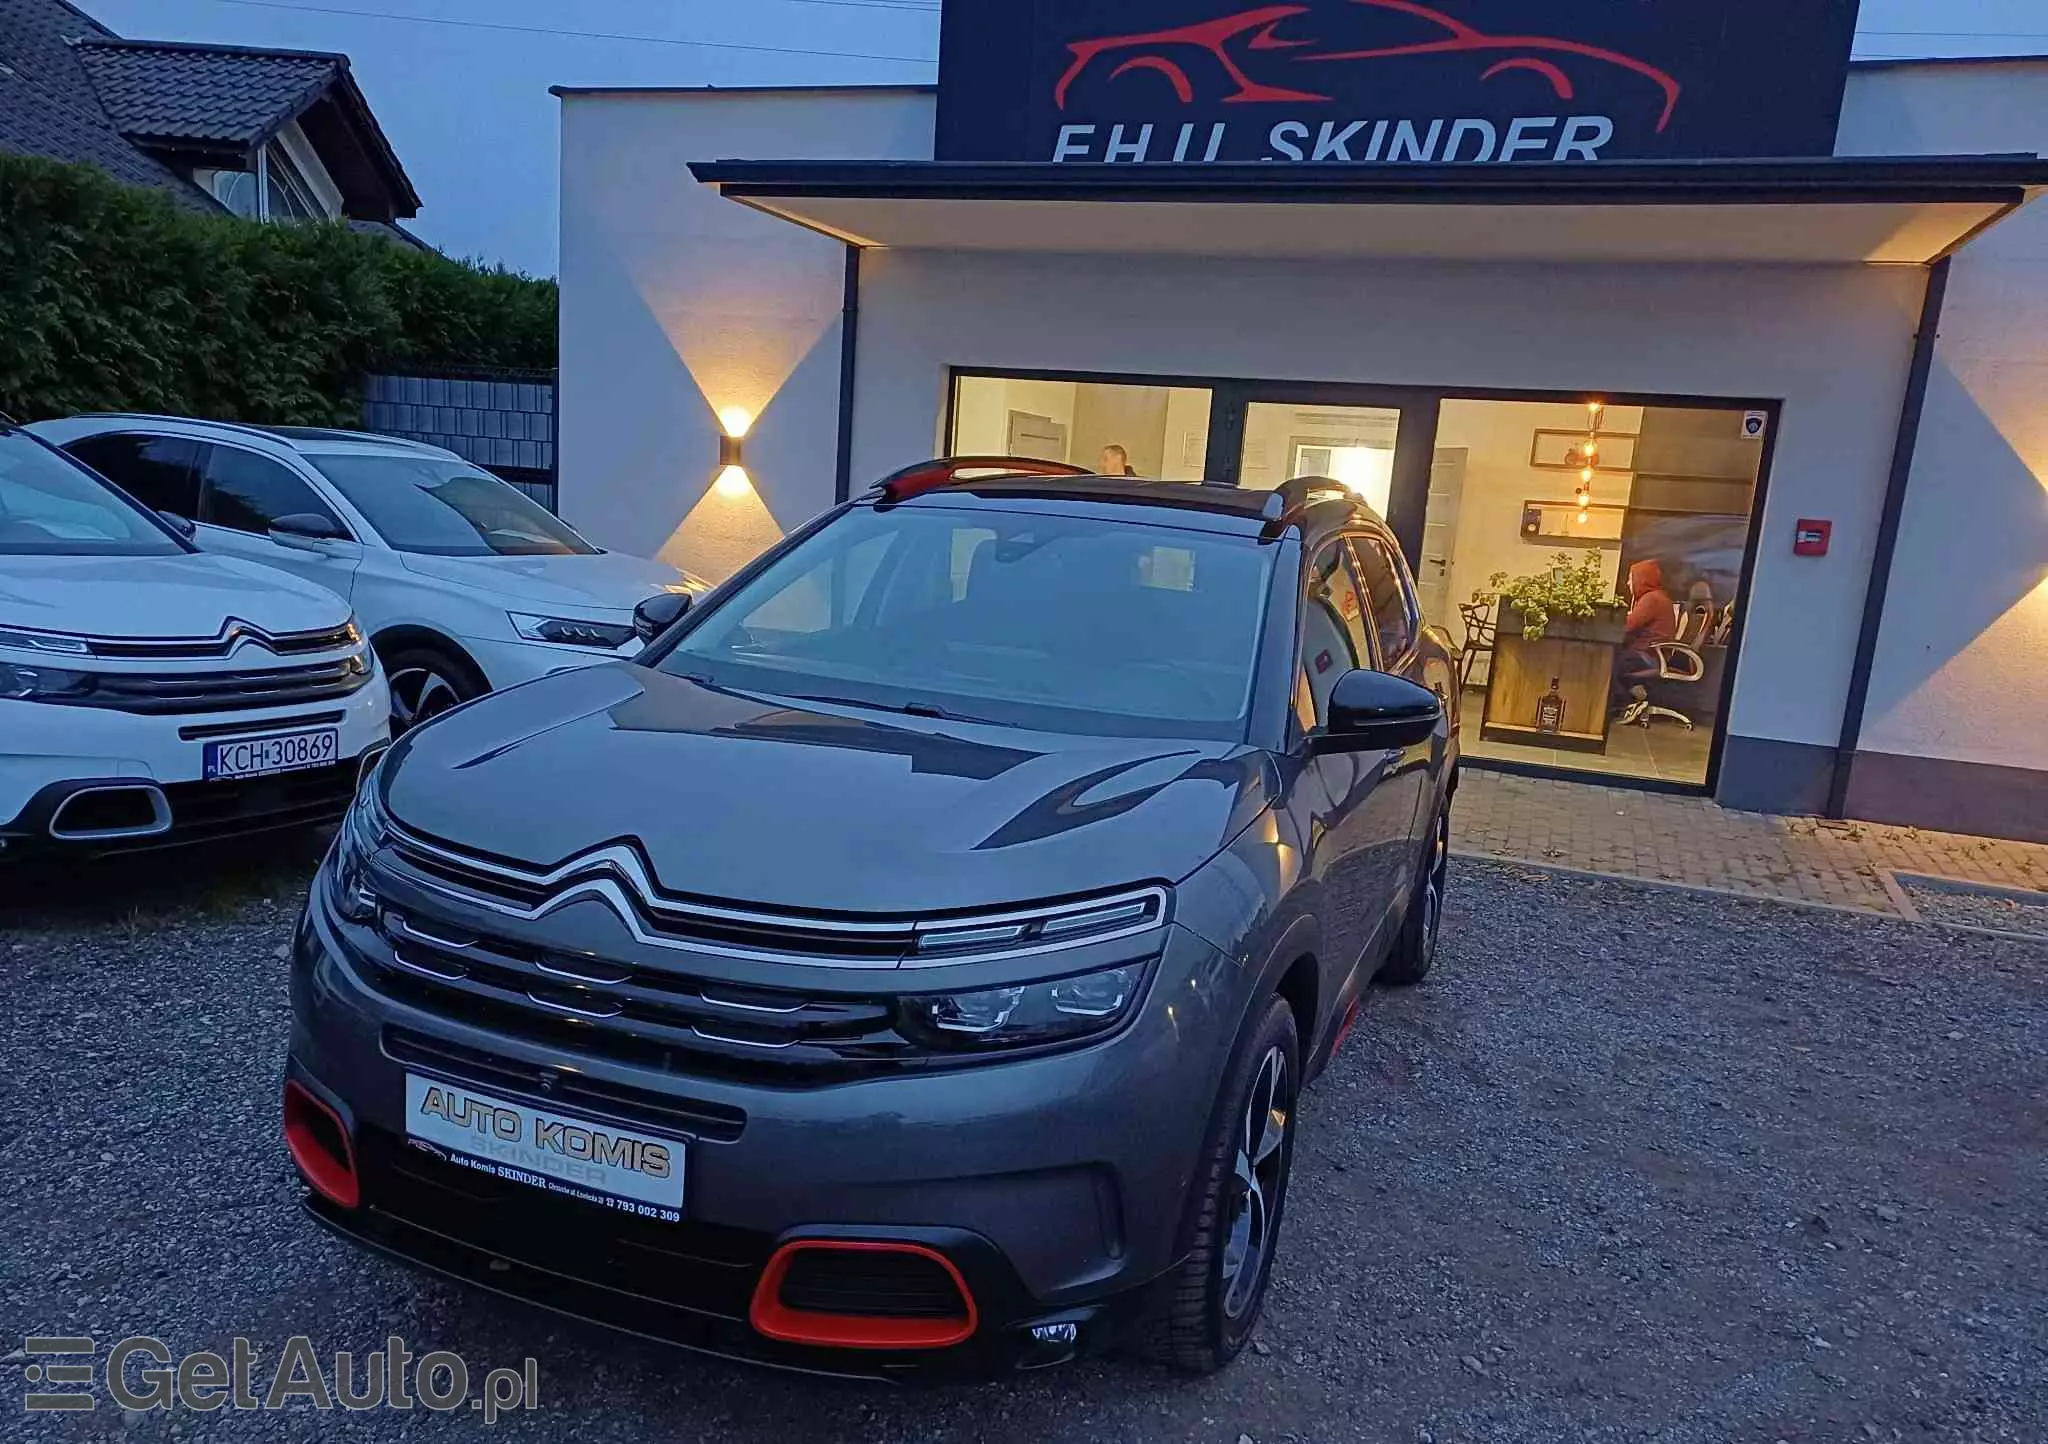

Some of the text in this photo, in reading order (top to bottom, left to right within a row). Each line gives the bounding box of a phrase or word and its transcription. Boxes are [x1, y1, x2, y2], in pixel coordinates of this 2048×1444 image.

[1260, 115, 1614, 162] SKINDER
[219, 742, 265, 774] KCH
[271, 734, 333, 766] 30869
[420, 1085, 672, 1180] AUTO KOMIS
[469, 1135, 607, 1185] SKINDER
[450, 1153, 681, 1223] Auto Komis SKINDER 793 002 309
